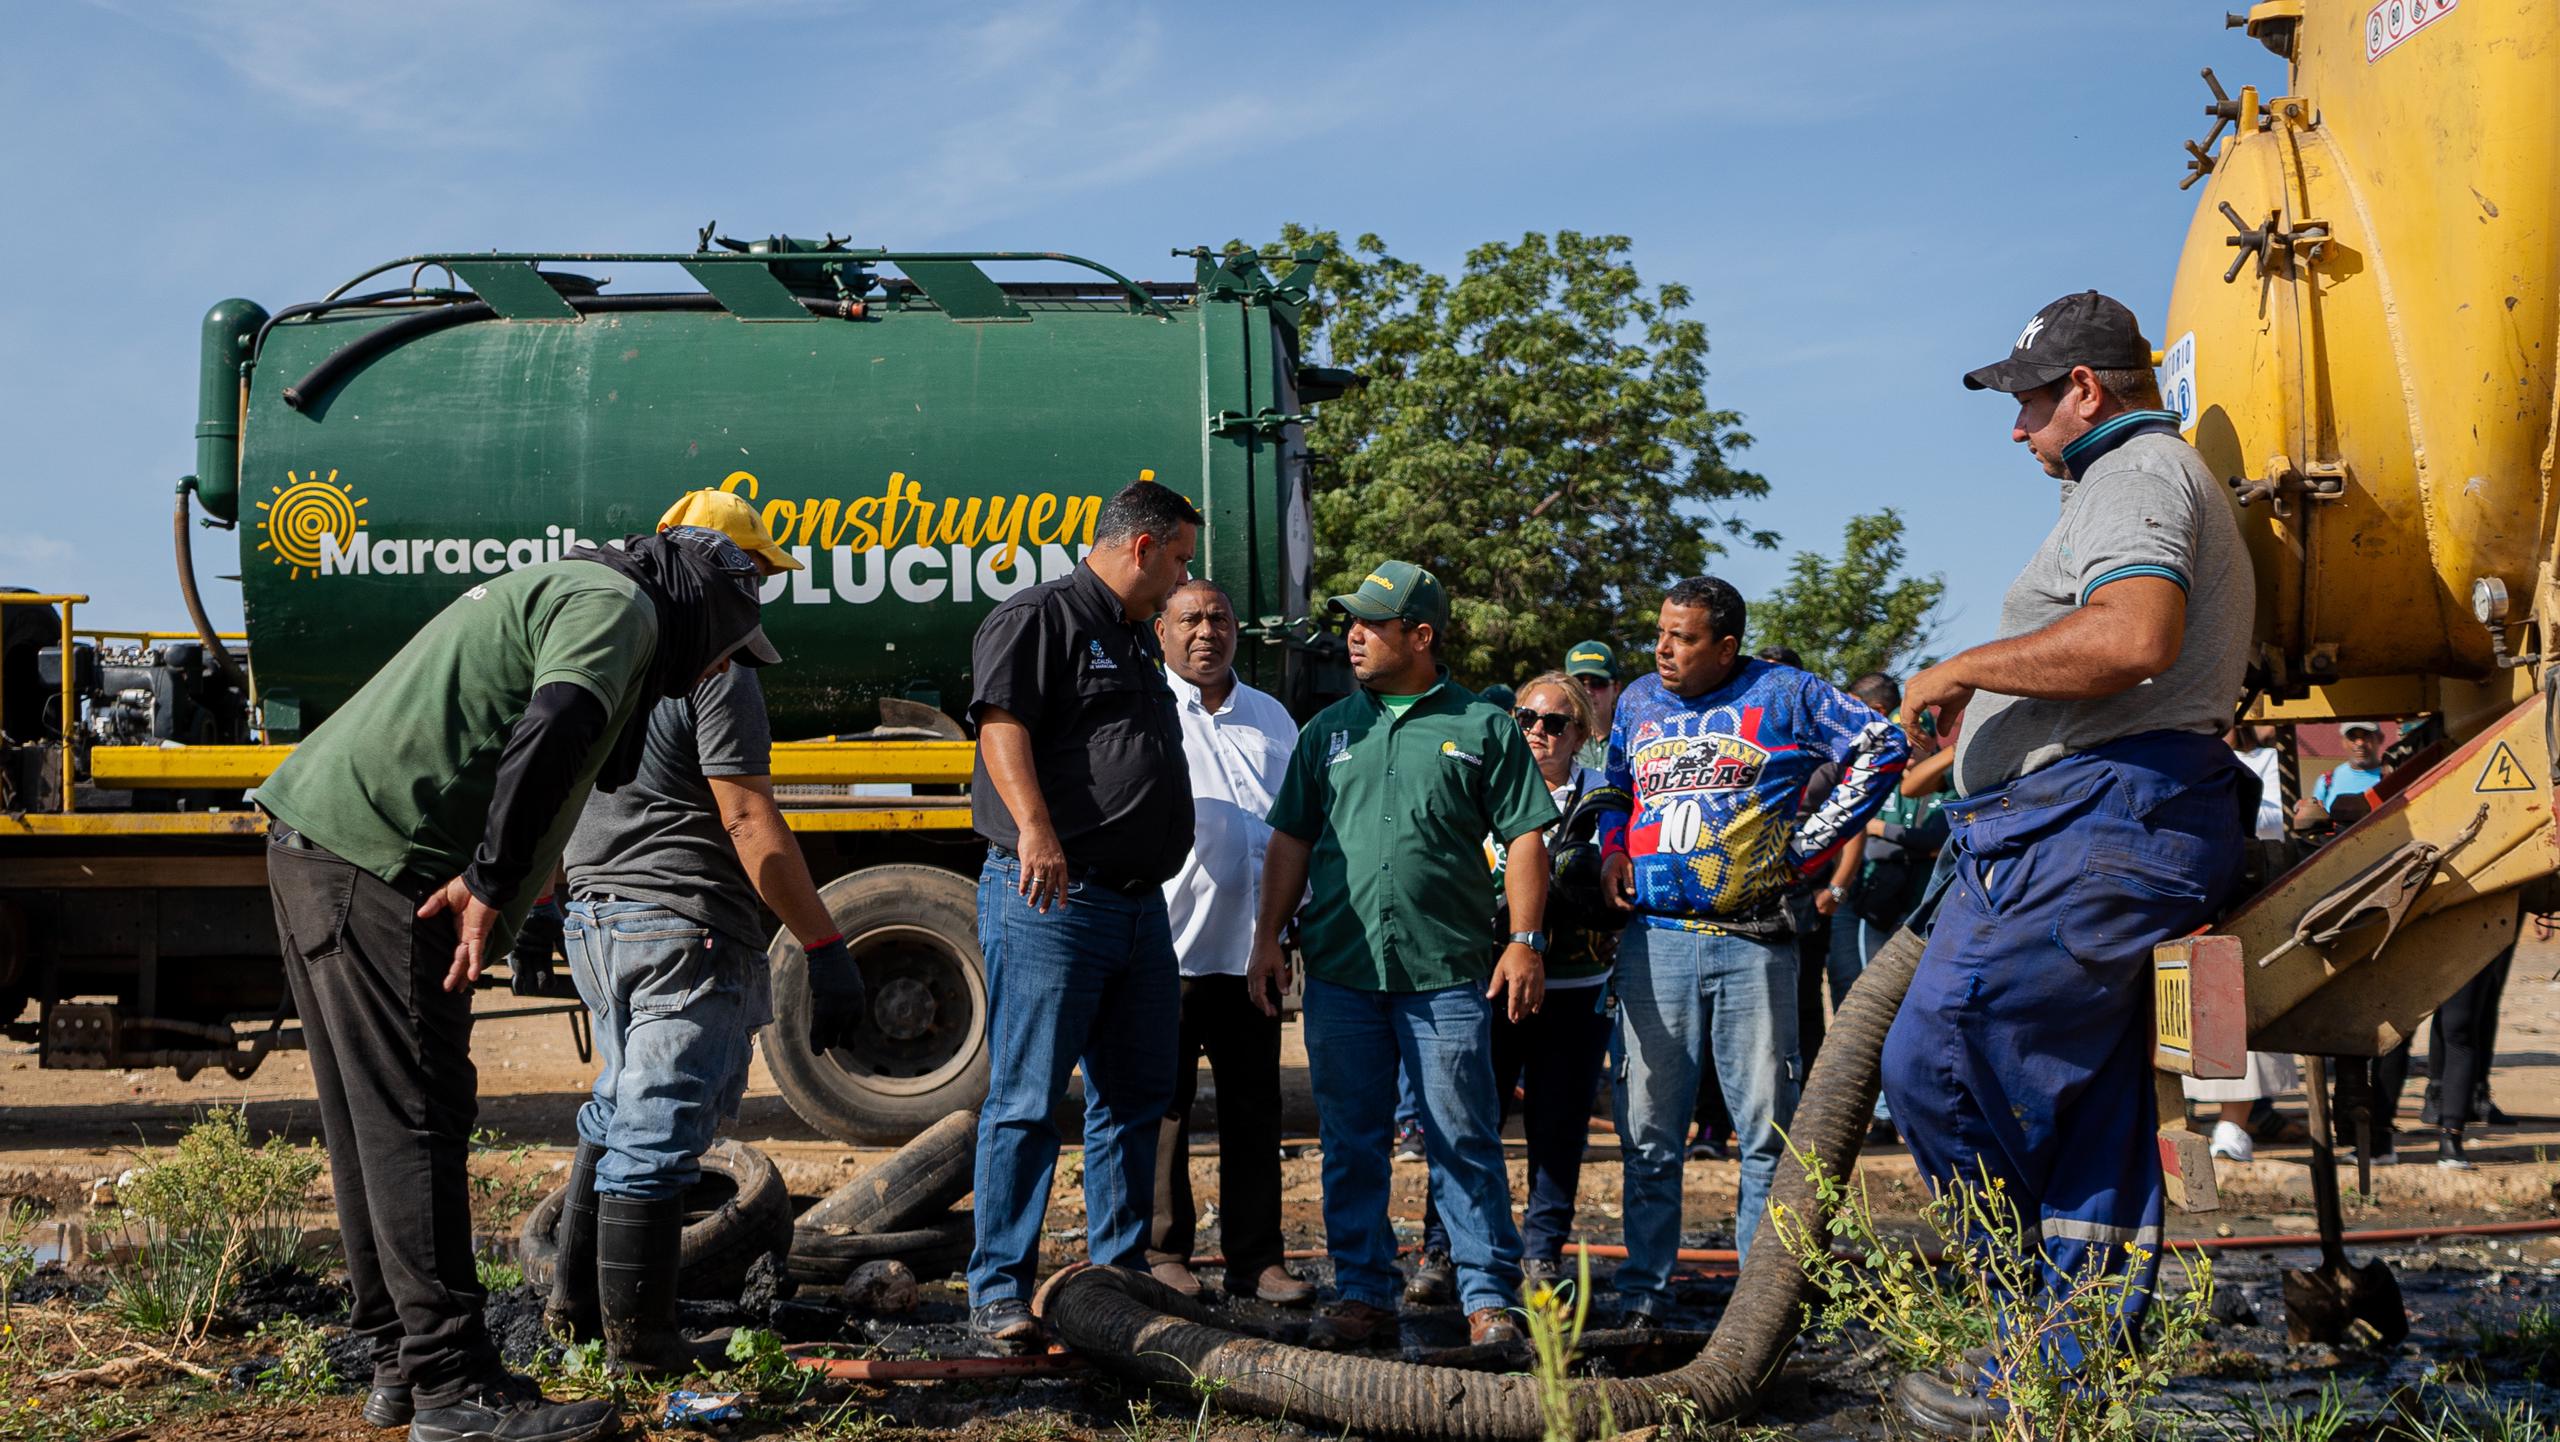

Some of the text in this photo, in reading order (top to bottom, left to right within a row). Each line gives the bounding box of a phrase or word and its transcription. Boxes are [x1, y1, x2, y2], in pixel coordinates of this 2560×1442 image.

[718, 470, 1200, 571] Construyen
[319, 523, 626, 576] Maracaib
[757, 543, 1193, 605] LUCION
[1635, 738, 1766, 769] MOTO TAXI
[1637, 764, 1758, 797] COLEGAS
[1656, 798, 1702, 855] 10
[2159, 978, 2188, 1040] LARGA
